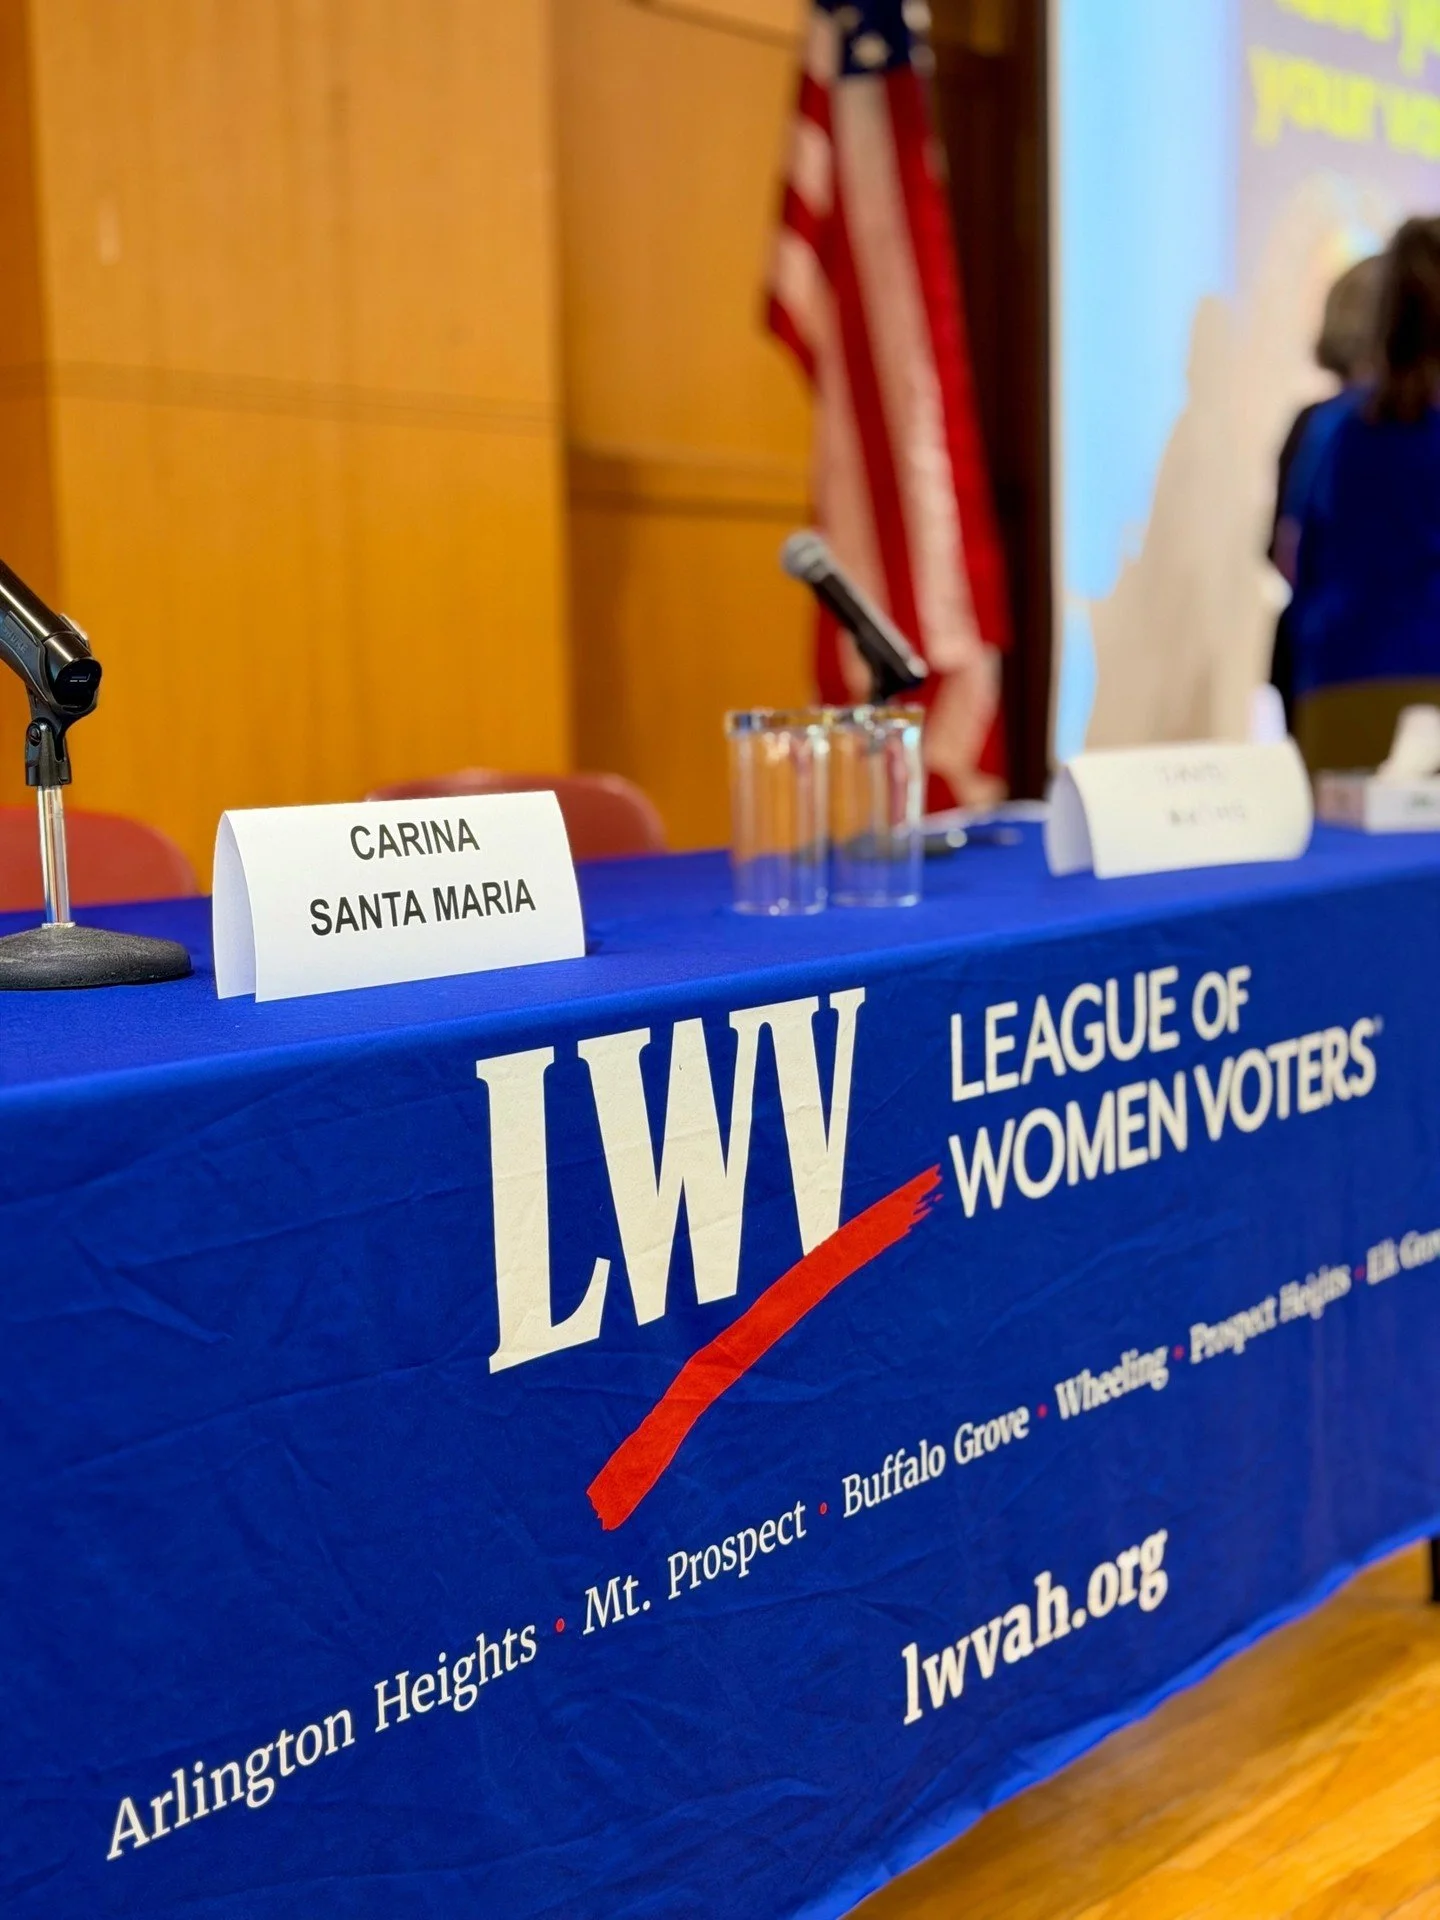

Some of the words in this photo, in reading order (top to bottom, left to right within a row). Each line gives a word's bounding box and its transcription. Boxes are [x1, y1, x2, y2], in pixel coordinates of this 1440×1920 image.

[309, 889, 427, 936] SANTA
[433, 878, 537, 922] MARIA
[350, 817, 480, 861] CARINA
[950, 965, 1180, 1102] LEAGUE
[1192, 965, 1251, 1042] OF
[475, 986, 866, 1374] LWV
[949, 1071, 1188, 1219] WOMEN
[106, 1709, 356, 1861] Arlington
[374, 1624, 537, 1733] Heights
[582, 1575, 651, 1635] Mt.
[667, 1500, 807, 1600] Prospect
[842, 1439, 946, 1518] Buffalo
[954, 1406, 1029, 1465] Grove
[1054, 1346, 1169, 1420] Wheeling
[1190, 1297, 1277, 1364] Prospect
[901, 1528, 1169, 1725] lwvah.org
